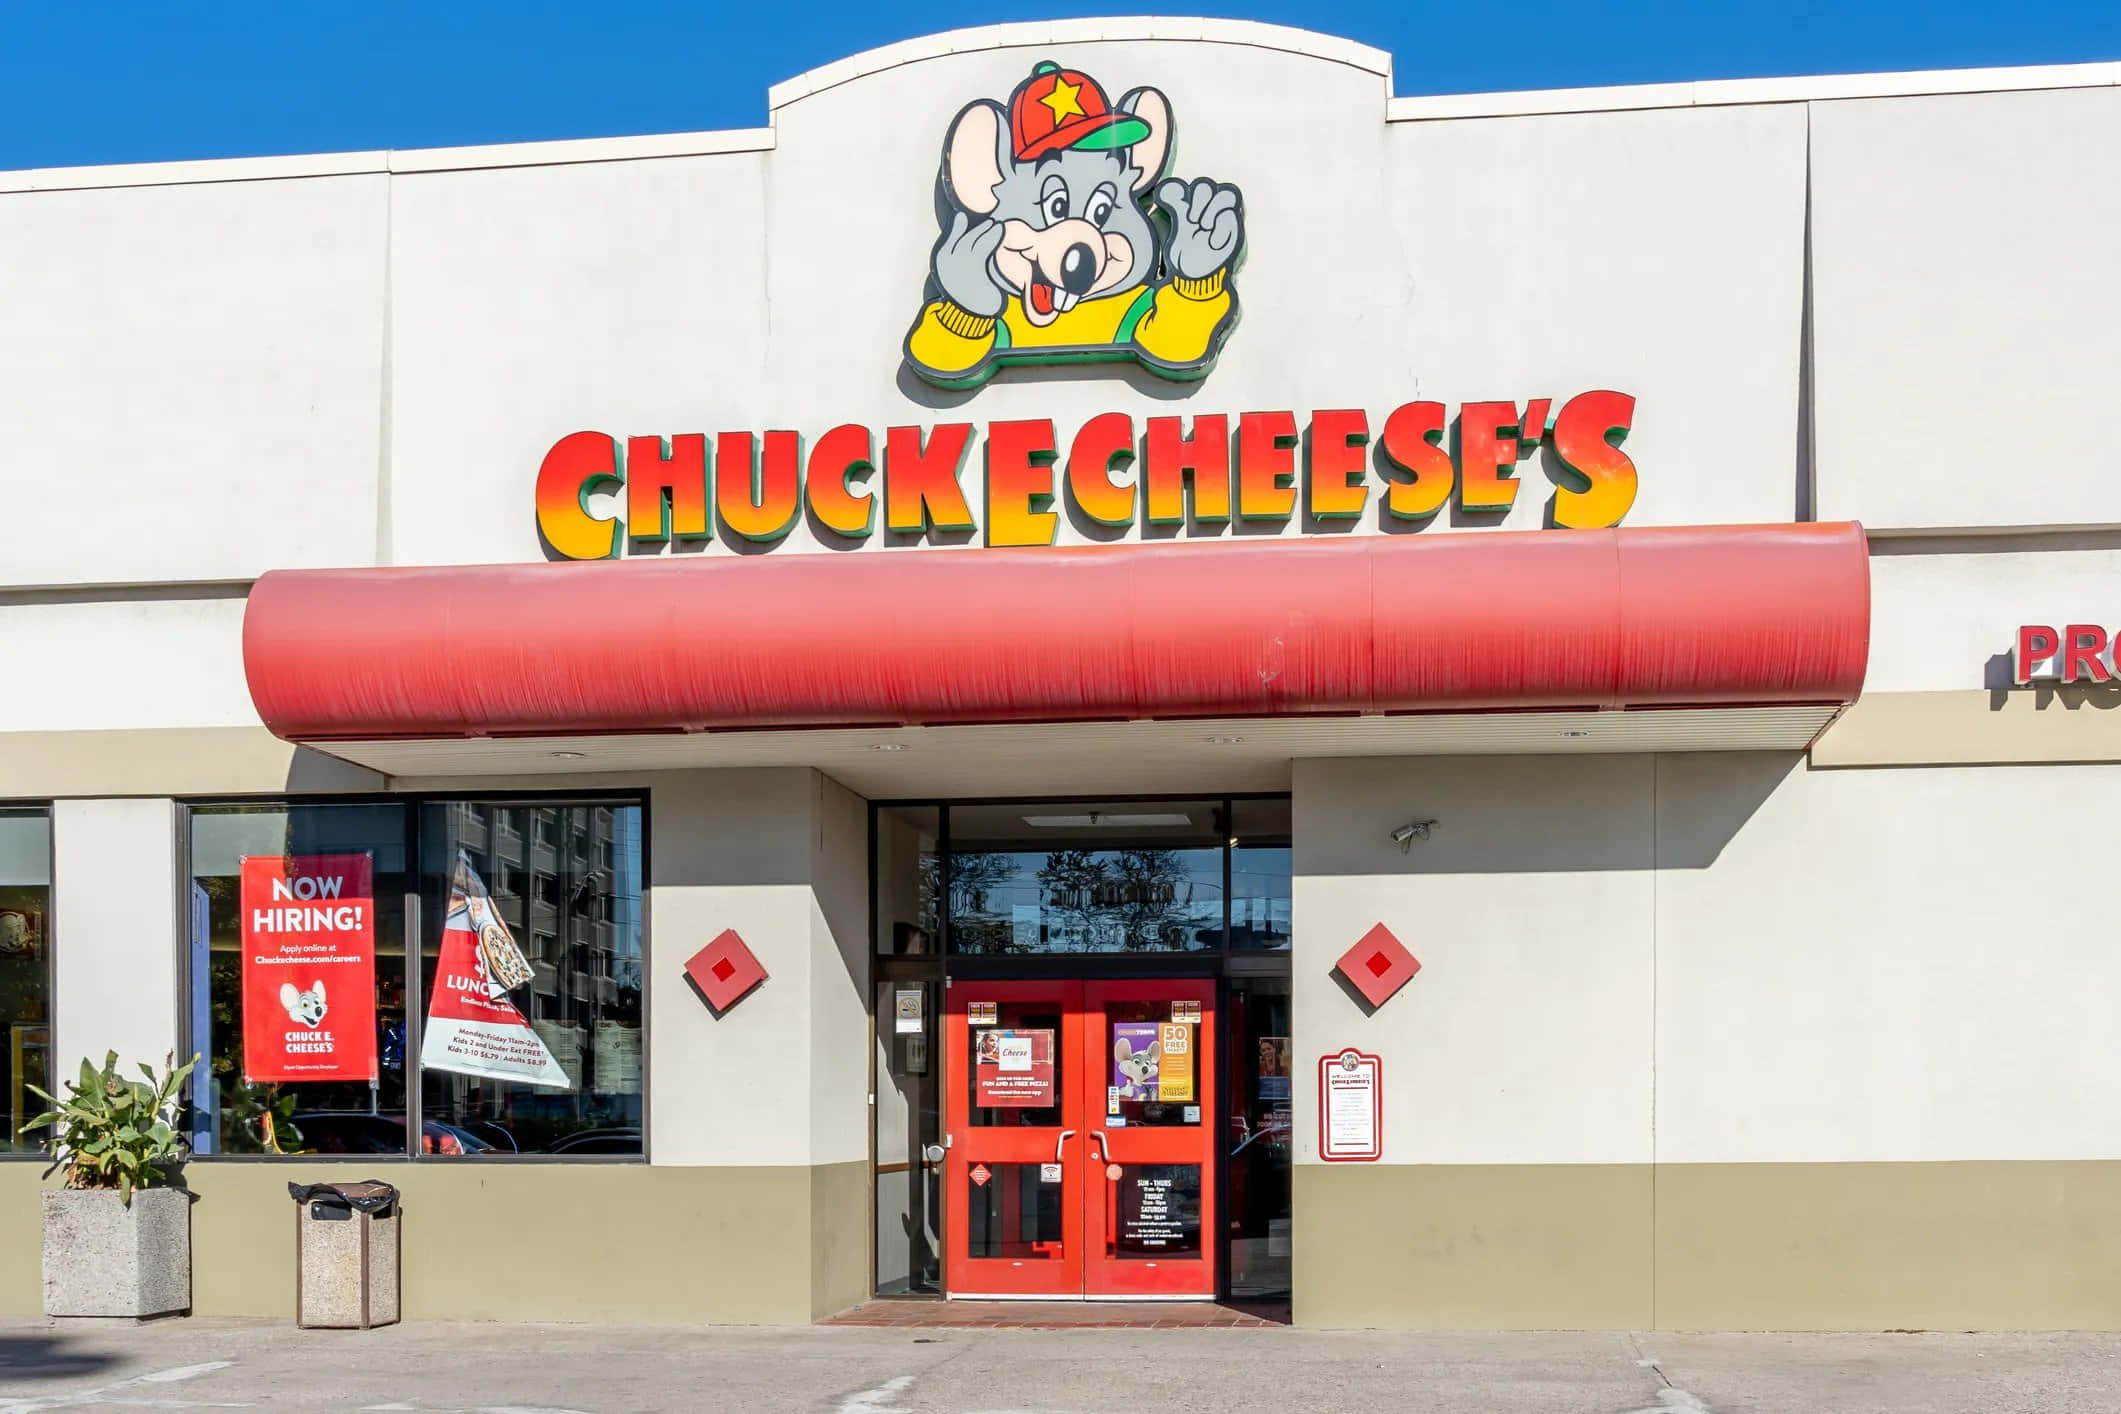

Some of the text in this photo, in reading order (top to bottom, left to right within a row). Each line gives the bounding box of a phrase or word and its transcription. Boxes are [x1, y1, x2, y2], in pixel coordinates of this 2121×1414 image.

[536, 390, 1639, 562] CHUCK E CHEESE'S
[2016, 624, 2121, 684] PR
[272, 876, 344, 901] NOW
[253, 906, 363, 932] HIRING!
[280, 944, 337, 954] Apply online at
[255, 955, 361, 964] Chuckecheese.com/careers
[446, 974, 490, 996] LUNC
[285, 1031, 322, 1042] CHUCK
[458, 1027, 540, 1048] Monday-Friday 11am-2pm
[1165, 1026, 1186, 1041] 50
[285, 1042, 334, 1054] CHEESE'S
[447, 1045, 463, 1055] Kids
[463, 1048, 479, 1057] 3-10
[503, 1055, 526, 1065] Adults
[453, 1036, 468, 1046] Kids
[475, 1041, 488, 1049] and
[488, 1044, 509, 1053] Under
[510, 1047, 522, 1055] Eat
